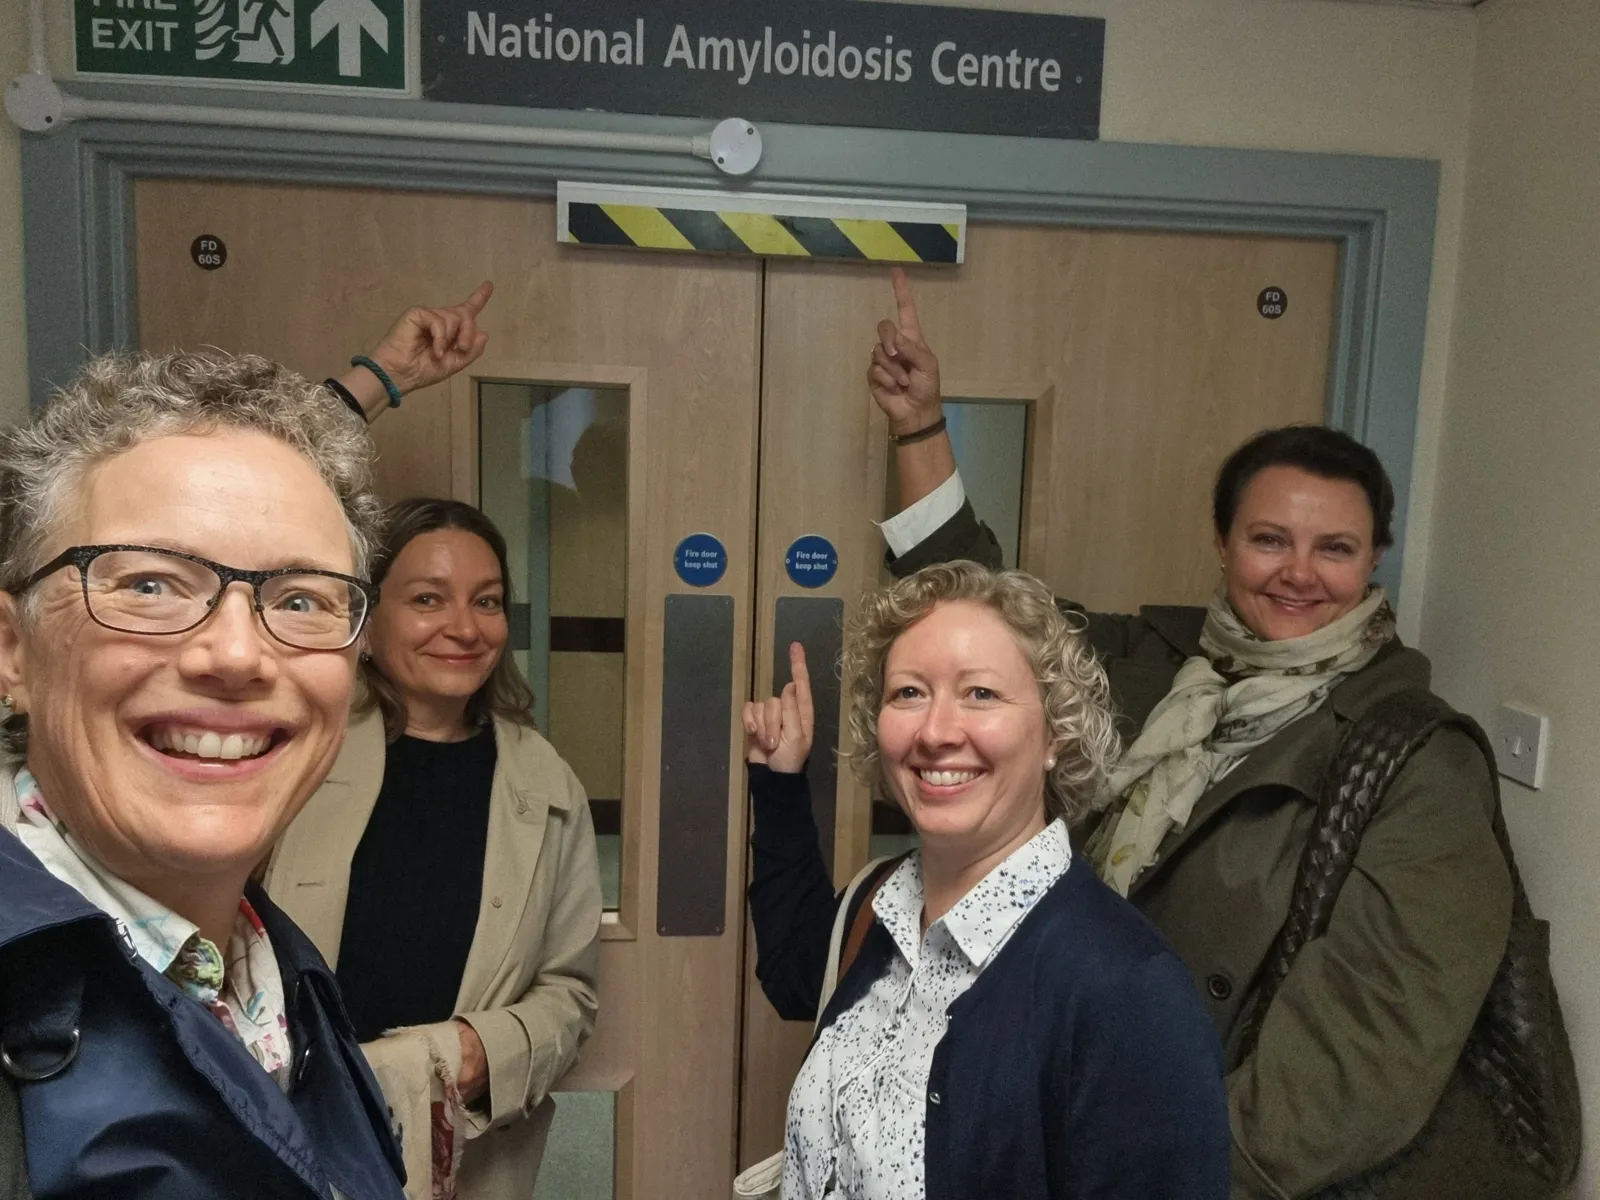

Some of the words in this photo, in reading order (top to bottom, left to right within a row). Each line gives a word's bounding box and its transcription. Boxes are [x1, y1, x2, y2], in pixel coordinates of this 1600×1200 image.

[92, 18, 179, 51] EXIT
[467, 11, 645, 66] National
[663, 24, 912, 85] Amyloidosis
[931, 41, 1061, 92] Centre
[200, 240, 217, 251] FD
[198, 254, 221, 265] 60S
[1266, 291, 1280, 302] FD
[1262, 304, 1282, 314] 60S
[685, 549, 700, 558] Fire
[701, 549, 718, 558] door
[796, 550, 810, 559] Fire
[811, 551, 828, 560] door
[684, 560, 702, 570] keep
[702, 560, 718, 569] shut
[795, 561, 812, 572] keep
[812, 562, 828, 571] shut
